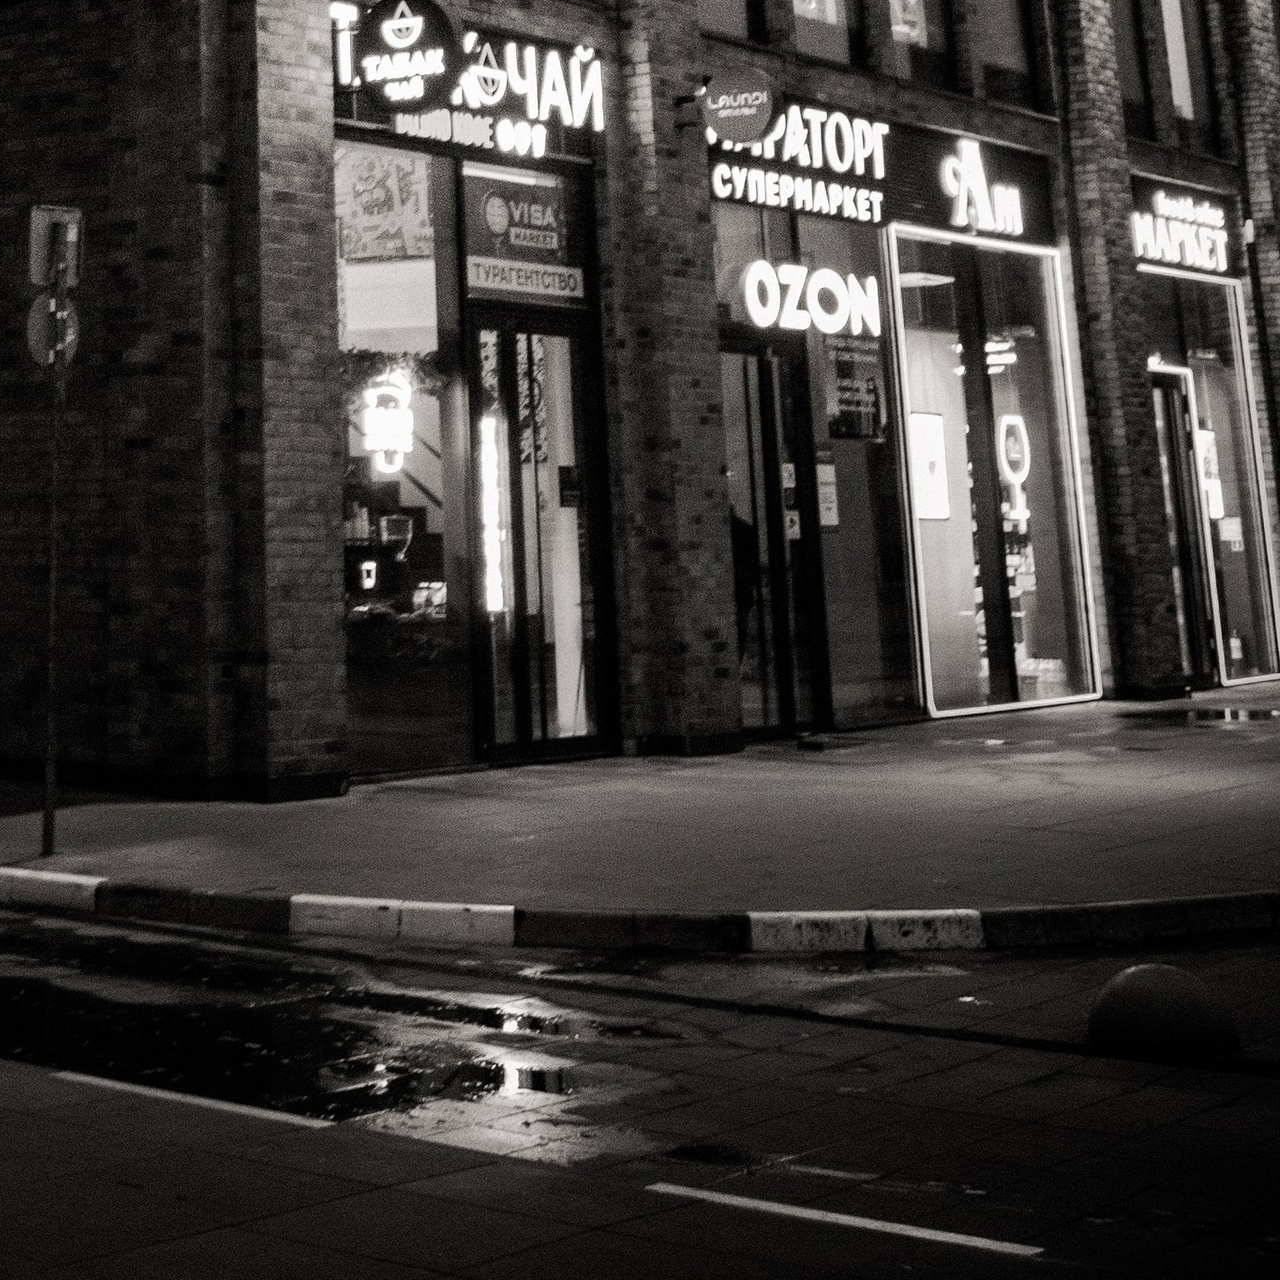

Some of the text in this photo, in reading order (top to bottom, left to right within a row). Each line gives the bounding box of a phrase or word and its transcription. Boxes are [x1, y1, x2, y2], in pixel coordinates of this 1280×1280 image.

[505, 41, 605, 133] ЧАЙ
[712, 162, 884, 223] СУПЕРМАРКЕТ
[473, 262, 578, 293] ТУРАГЕНТСТВО
[744, 258, 882, 338] OZON
